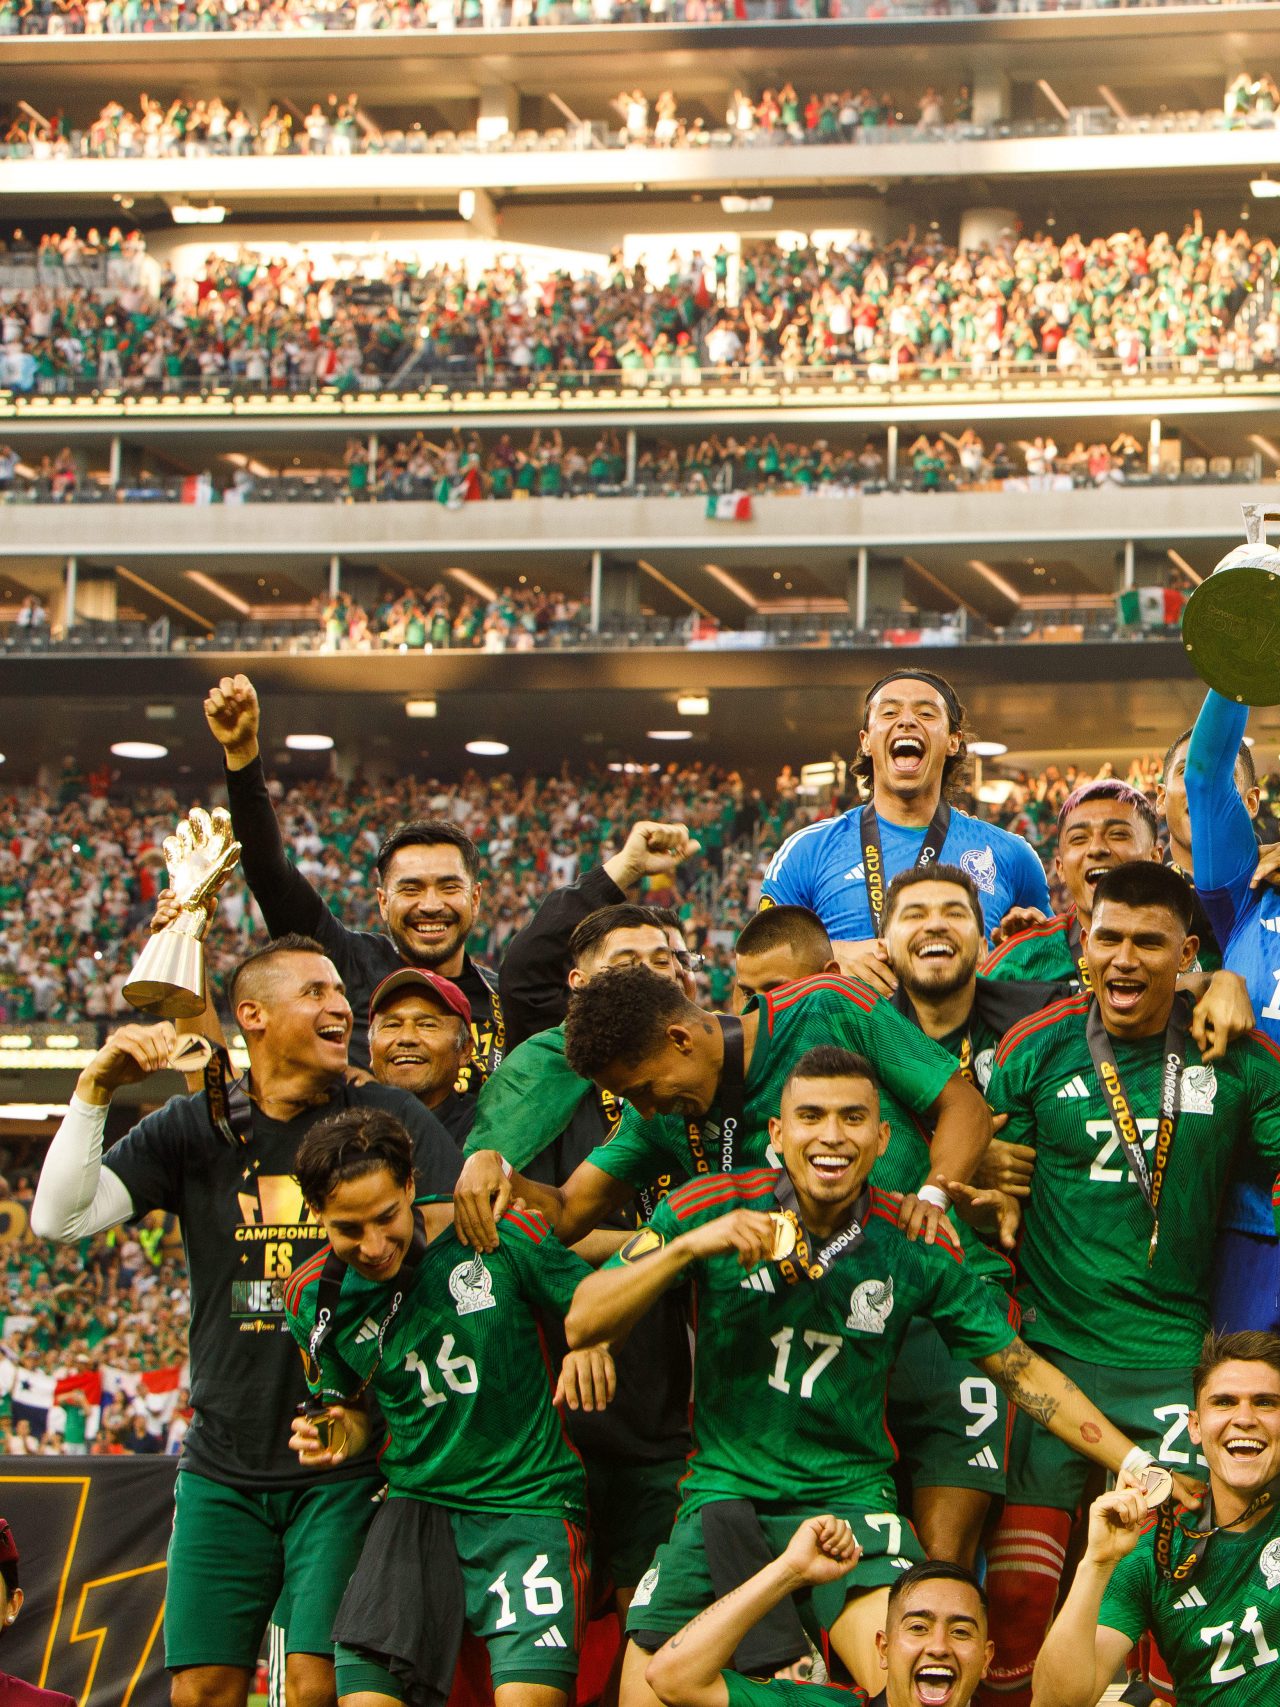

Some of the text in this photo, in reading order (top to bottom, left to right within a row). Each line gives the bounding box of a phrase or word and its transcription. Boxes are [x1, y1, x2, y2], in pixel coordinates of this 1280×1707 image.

[865, 844, 880, 872] CUP
[868, 873, 883, 912] GOLD
[453, 1066, 472, 1094] S
[1100, 1061, 1121, 1096] CUP
[601, 1089, 620, 1122] CUP
[1112, 1095, 1137, 1144] GOLD
[722, 1117, 738, 1172] Concac
[1151, 1053, 1181, 1207] Concacaf GOLD CUP
[234, 1226, 327, 1241] CAMPEONES
[820, 1220, 862, 1268] oncacaf
[264, 1242, 293, 1280] ES
[231, 1279, 288, 1312] NUES
[404, 1333, 479, 1408] 16
[768, 1326, 843, 1399] 17
[960, 1376, 998, 1438] 9
[1157, 1516, 1173, 1566] GOLD
[1173, 1553, 1198, 1579] CUP
[488, 1554, 564, 1630] 16
[1200, 1606, 1279, 1685] 21
